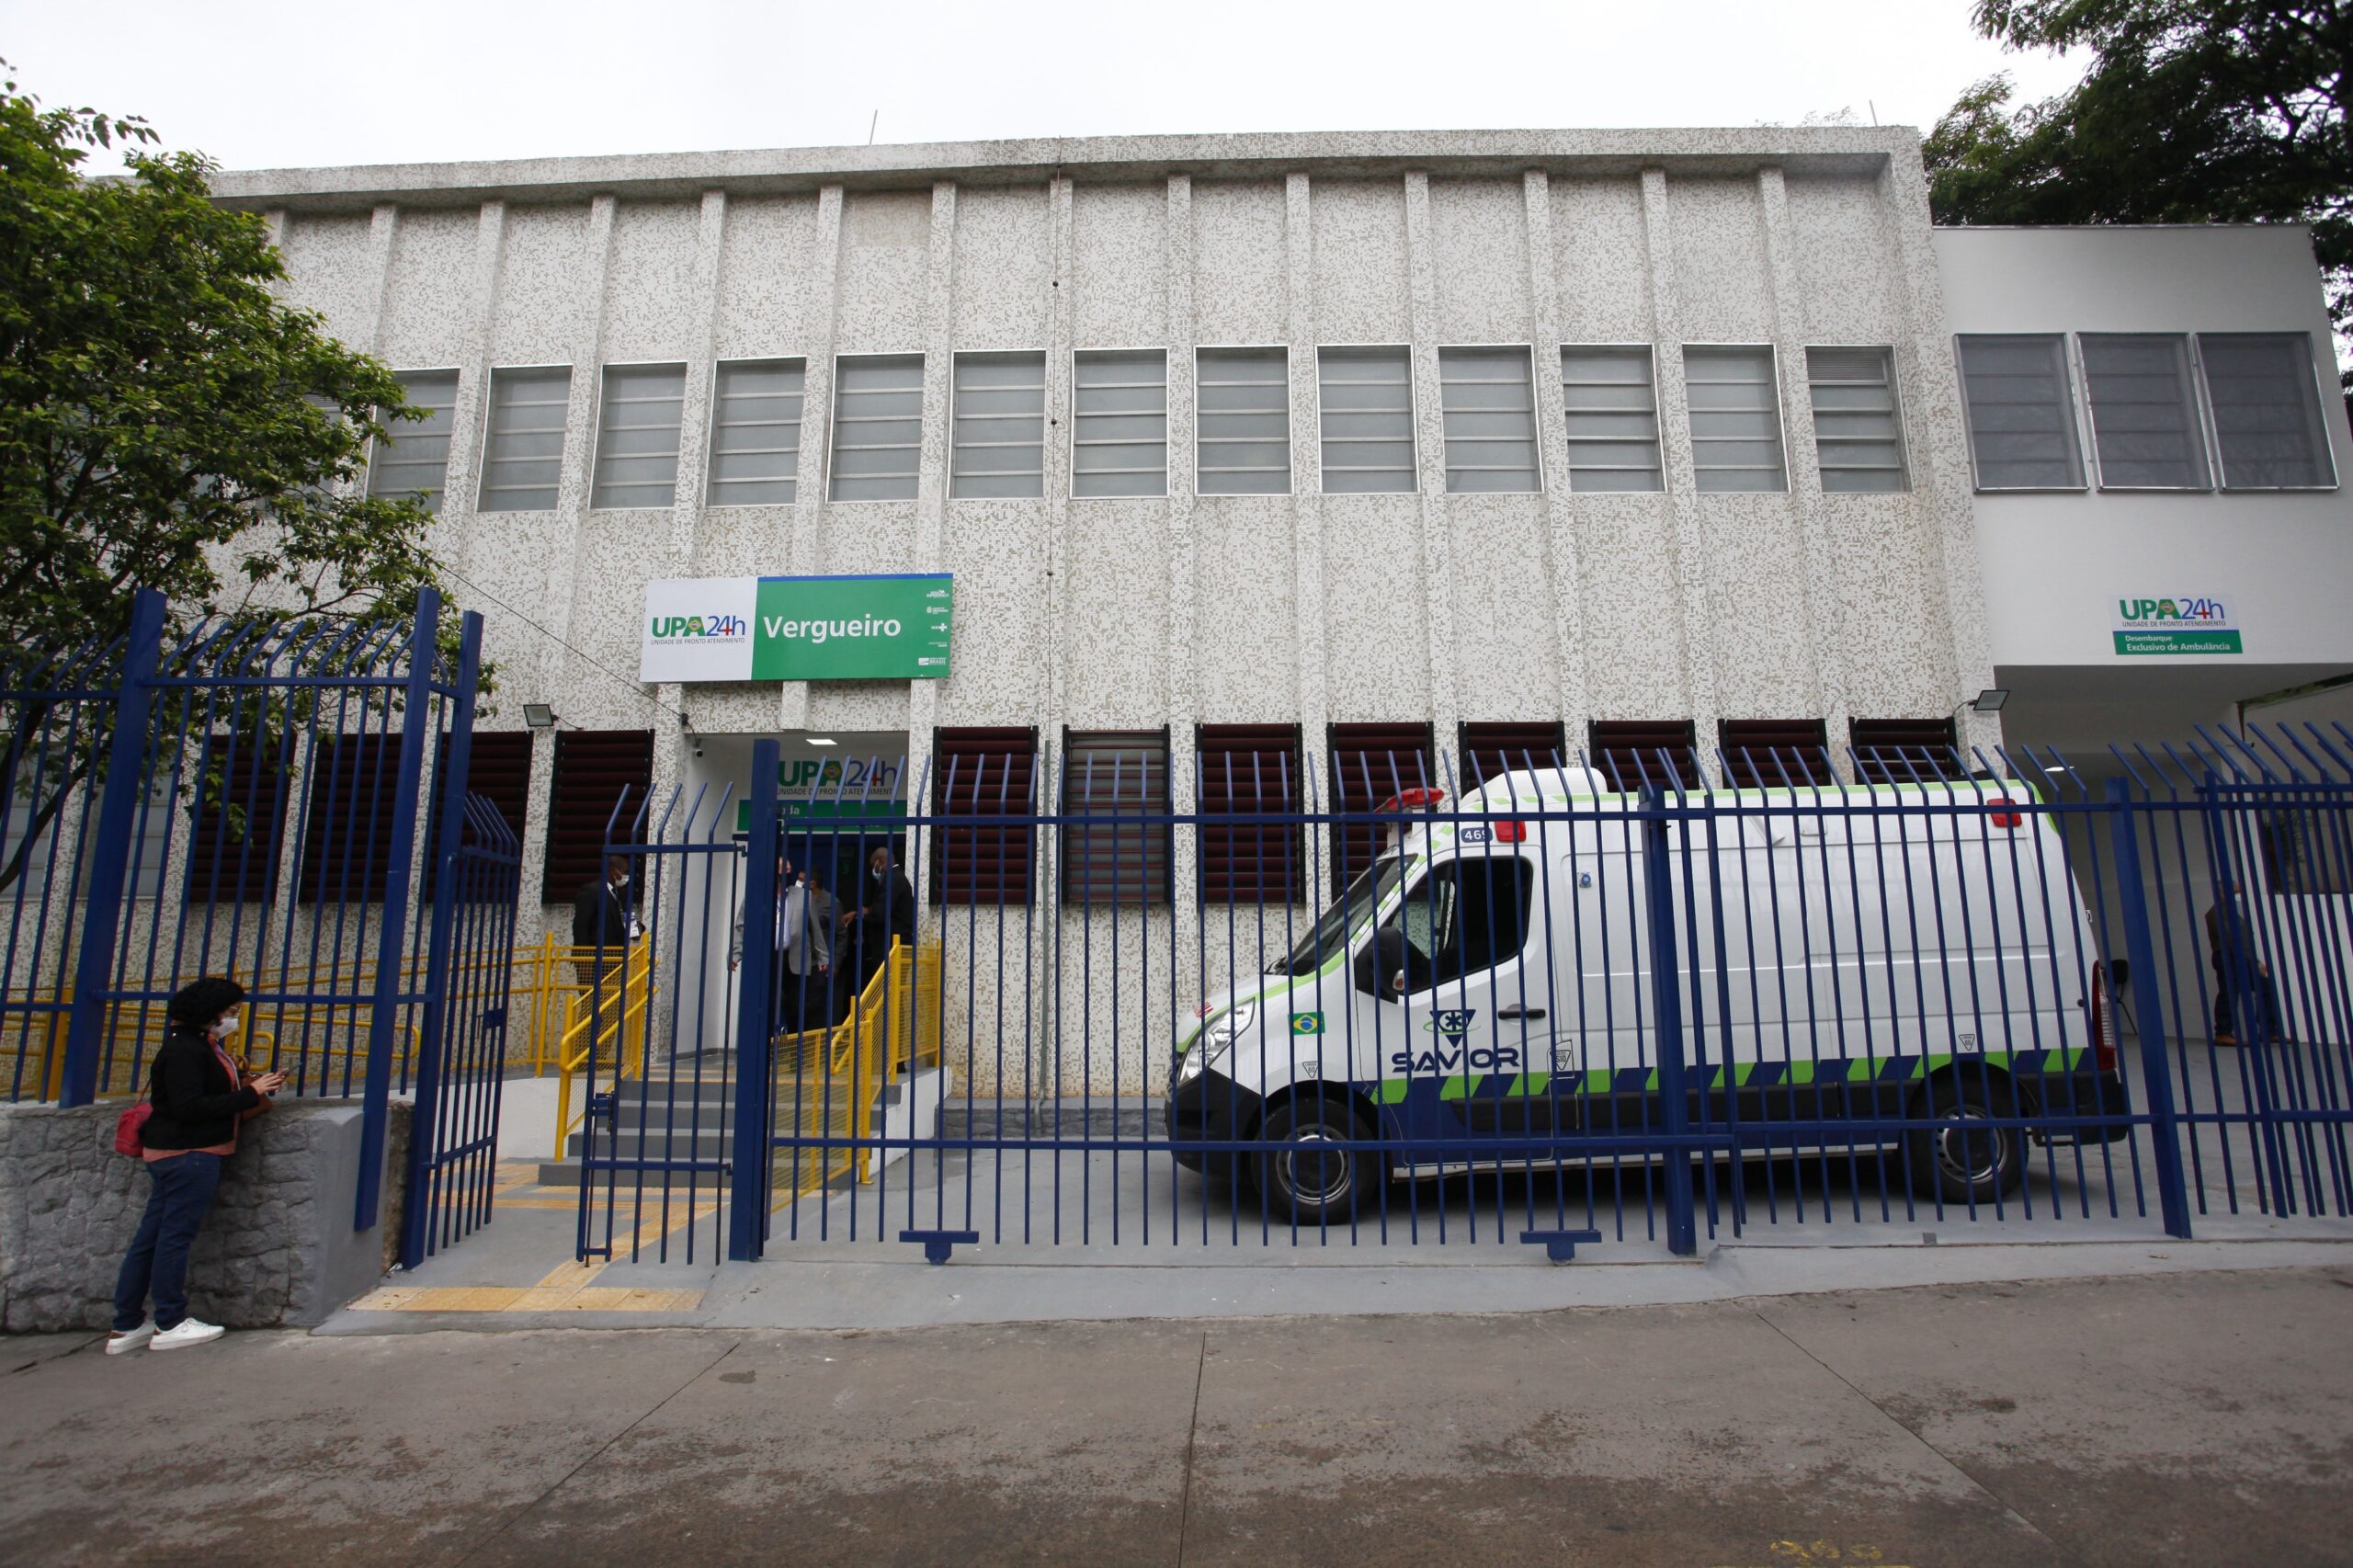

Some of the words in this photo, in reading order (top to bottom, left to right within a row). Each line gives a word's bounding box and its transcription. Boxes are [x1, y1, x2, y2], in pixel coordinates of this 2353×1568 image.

[763, 613, 902, 643] Vergueiro
[2124, 634, 2173, 642] Desembarque
[2126, 643, 2165, 652] Exclusivo
[2166, 642, 2178, 651] de
[2180, 642, 2231, 651] Ambulância
[819, 787, 847, 795] PRONO
[848, 787, 898, 795] ATENDIMENT
[1392, 1048, 1519, 1073] SAVOR
